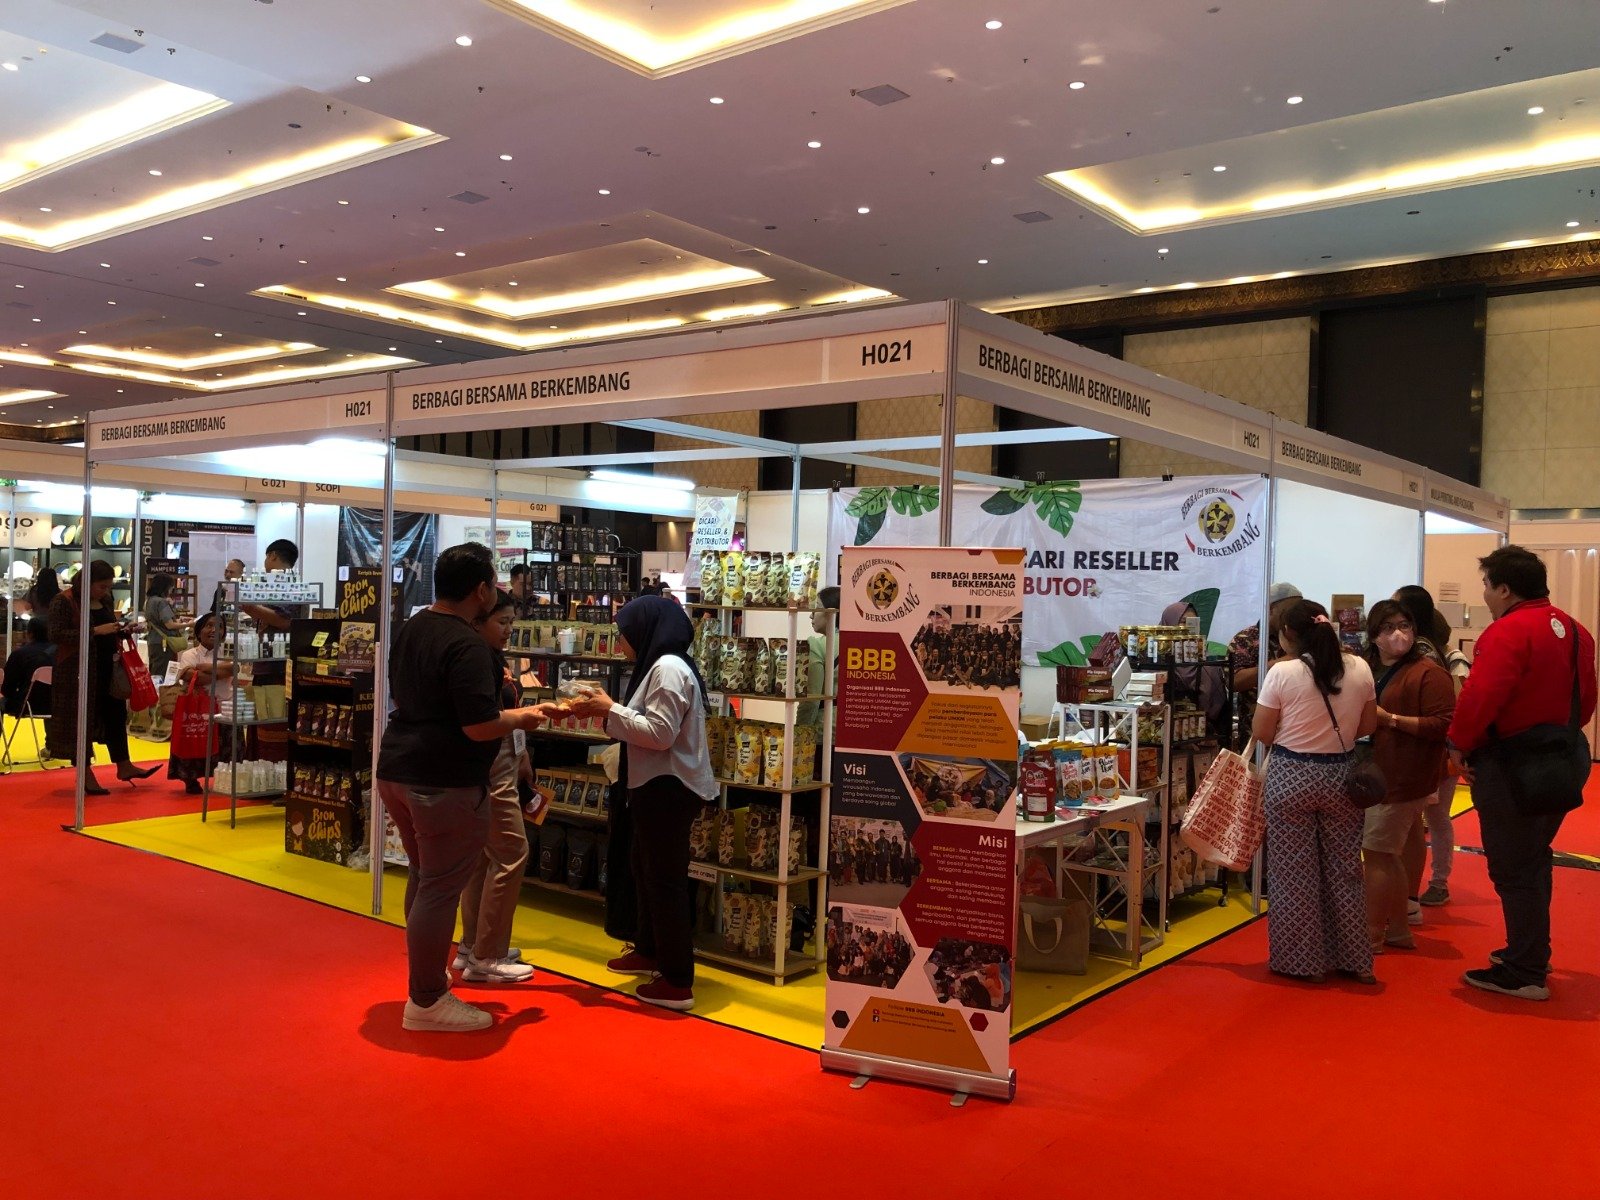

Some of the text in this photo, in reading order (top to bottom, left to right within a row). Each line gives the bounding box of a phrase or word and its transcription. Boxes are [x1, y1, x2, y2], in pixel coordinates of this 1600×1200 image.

[862, 339, 911, 366] H021
[978, 344, 1151, 417] BERBAGI BERSAMA BERKEMBANG
[412, 372, 631, 410] BERBAGI BERSAMA BERKEMBANG
[345, 400, 371, 417] H021
[101, 416, 226, 441] BERBAGI BERSAMA BERKEMBANG
[1244, 430, 1260, 449] H021
[1281, 441, 1362, 476] BERBAGI BERSAMA BERKEMBANG
[262, 478, 286, 488] G 021
[315, 483, 340, 493] SCOPI
[530, 503, 534, 511] G
[1181, 487, 1231, 520] BERBAGI BERSAMA
[1197, 512, 1260, 557] BERKEMBANG
[1024, 551, 1179, 571] ARI RESELLER
[852, 558, 895, 588] BERBAGI BERSAMA
[931, 571, 1016, 581] BERBAGI BERSAMA
[952, 580, 1016, 589] BERKEMBANG
[969, 589, 1015, 598] INDONESIA
[339, 585, 375, 619] Chips
[865, 583, 920, 623] BERKEMBANG
[846, 647, 896, 671] BBB
[846, 670, 896, 681] INDONESIA
[843, 763, 866, 776] Visi
[1219, 773, 1242, 790] LONDO
[308, 820, 341, 843] Chips
[978, 835, 1007, 849] Misi
